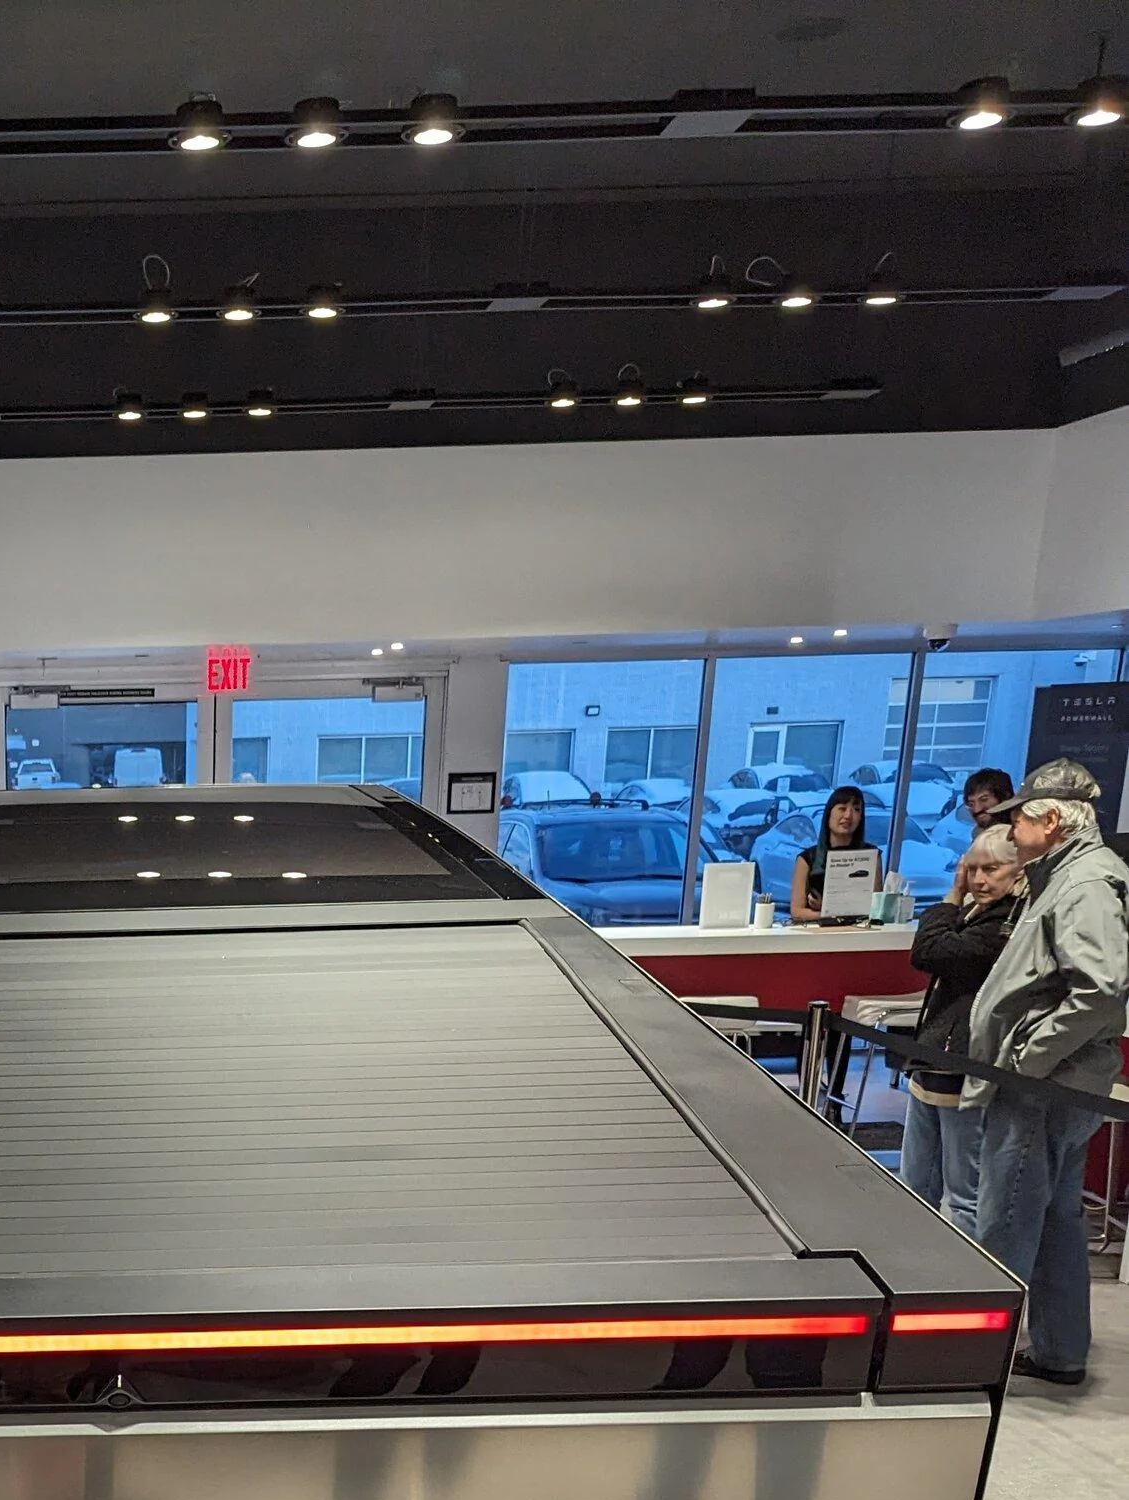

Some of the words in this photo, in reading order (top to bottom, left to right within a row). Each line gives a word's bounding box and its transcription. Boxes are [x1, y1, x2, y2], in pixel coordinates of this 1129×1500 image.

[208, 658, 251, 690] EXIT
[1063, 696, 1116, 707] TESLA
[1060, 714, 1113, 722] POWERWALL
